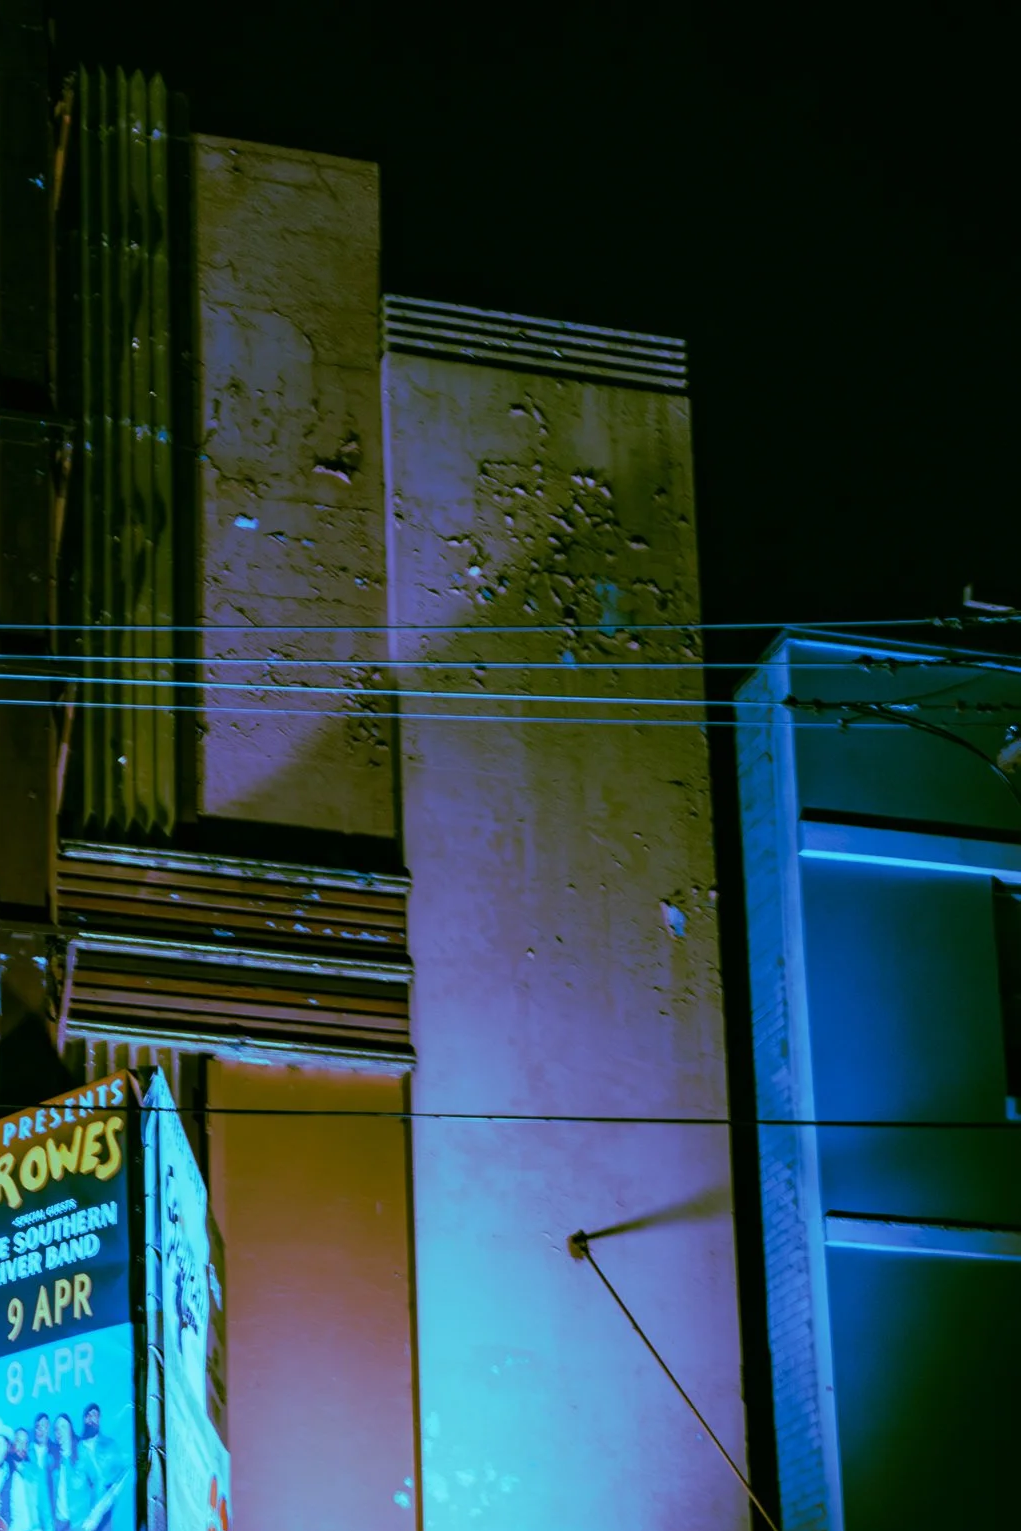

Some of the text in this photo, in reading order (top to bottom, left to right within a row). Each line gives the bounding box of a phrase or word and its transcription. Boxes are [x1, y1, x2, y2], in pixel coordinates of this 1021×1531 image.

[2, 1078, 124, 1147] PRESENTS
[13, 1201, 118, 1255] SOUTHERN
[45, 1233, 101, 1270] BAND
[7, 1272, 94, 1342] 9 APR
[6, 1341, 94, 1405] 8 APR
